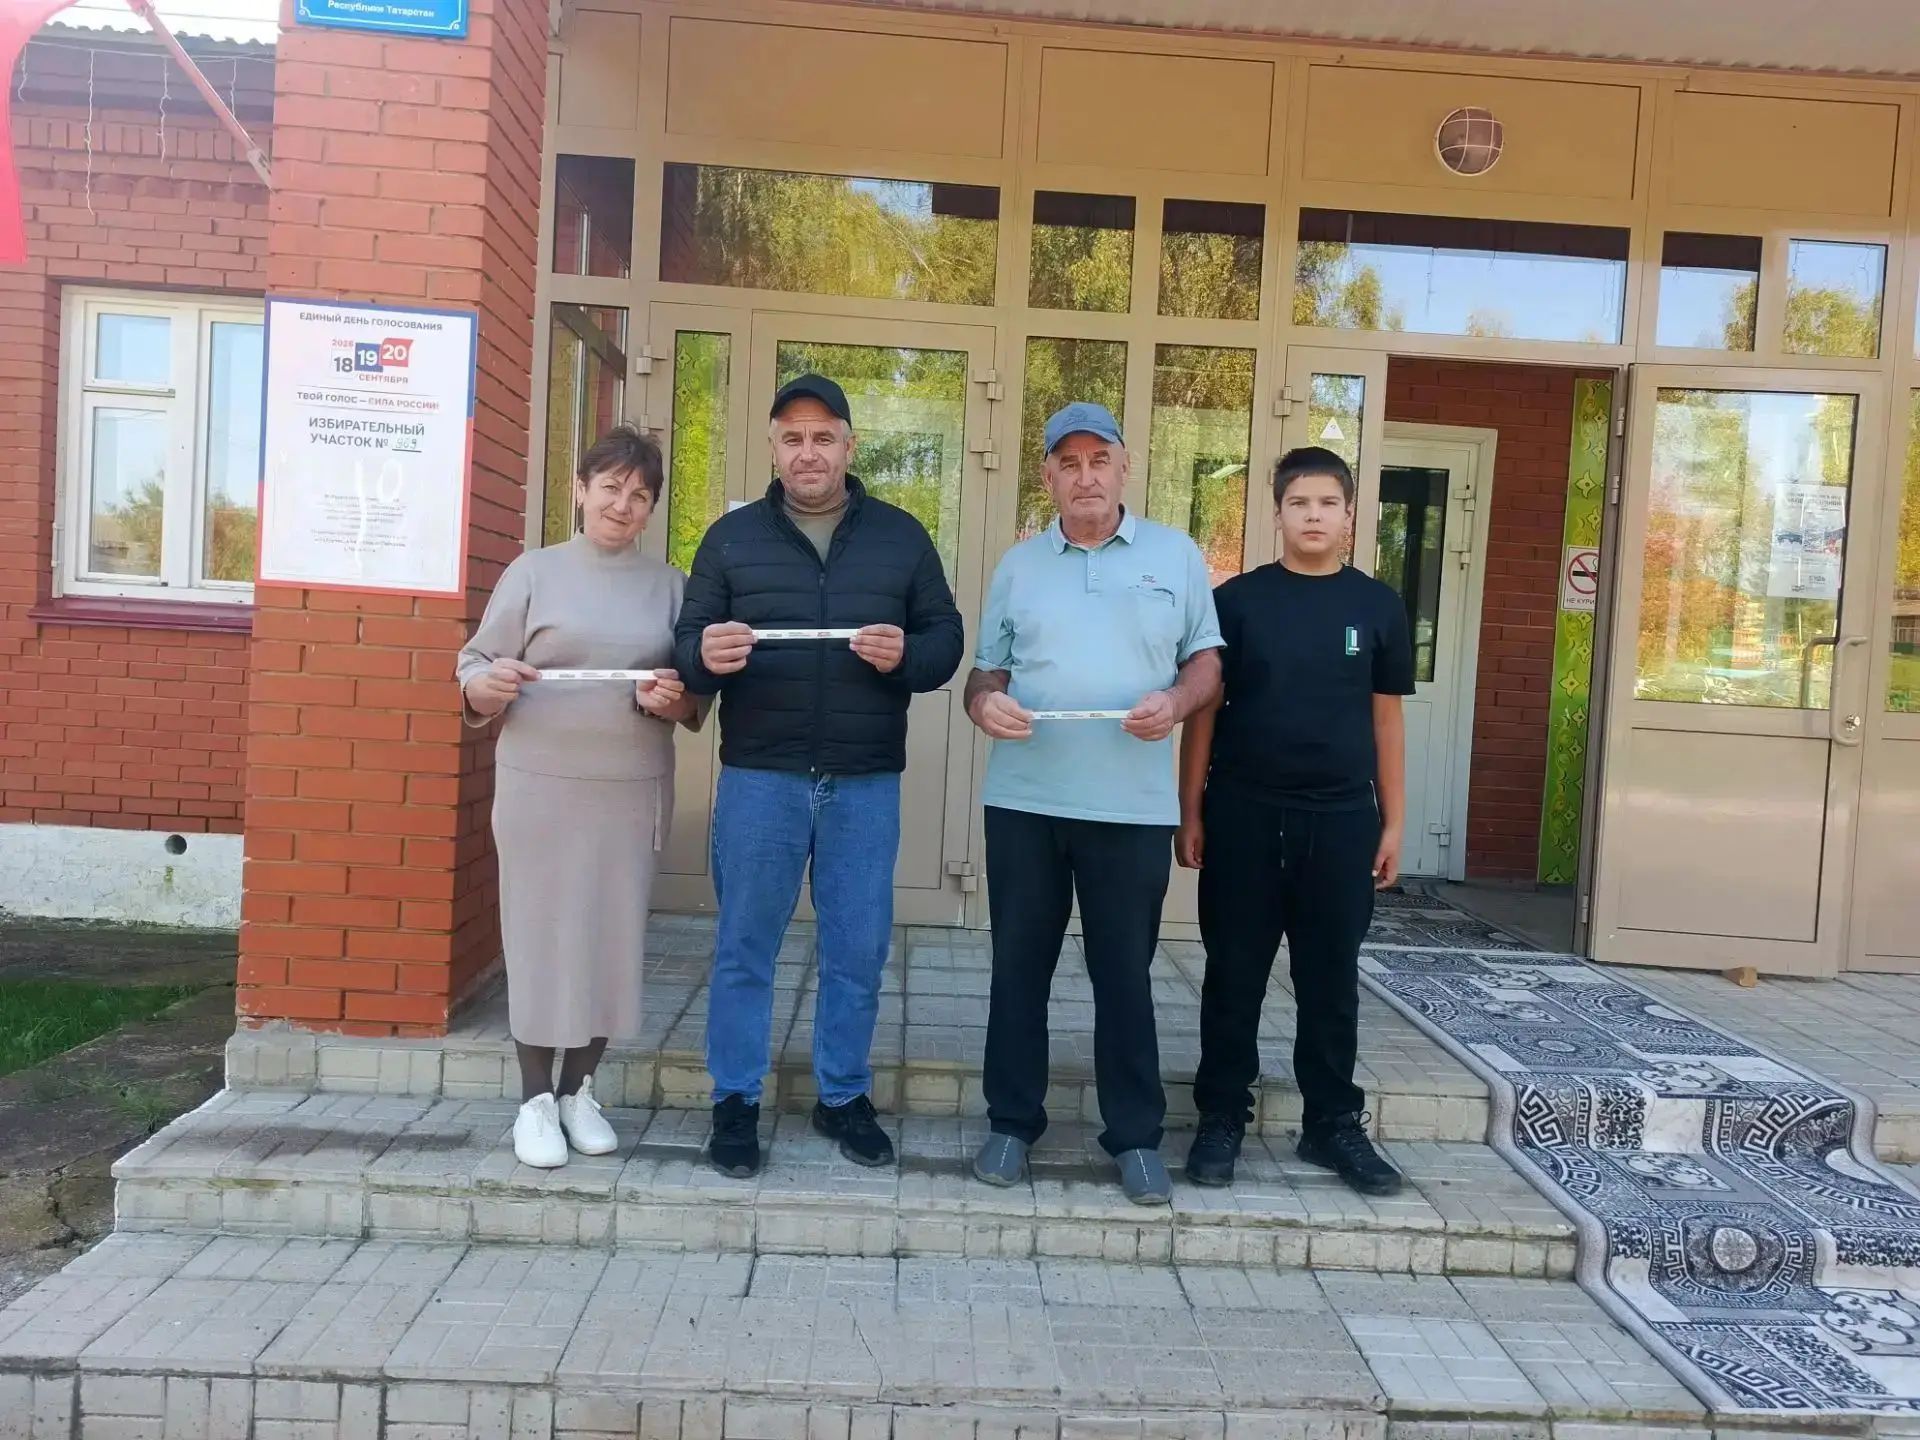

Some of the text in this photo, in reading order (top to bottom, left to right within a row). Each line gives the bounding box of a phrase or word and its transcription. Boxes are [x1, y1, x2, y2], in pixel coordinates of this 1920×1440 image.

[386, 5, 434, 18] Татарстан
[299, 311, 443, 331] ЕДИНЫЙ ДЕНЬ ГОЛОСОВАНИЯ
[333, 344, 408, 373] 18 19 20
[358, 373, 409, 384] СЕНТЯБРЯ
[297, 391, 323, 401] ТВОЙ
[325, 394, 359, 404] ГОЛОС
[368, 397, 395, 407] СИЛА
[308, 417, 425, 436] ИЗБИРАТЕЛЬНЫЙ
[310, 432, 372, 448] УЧАСТОК
[375, 437, 389, 449] №
